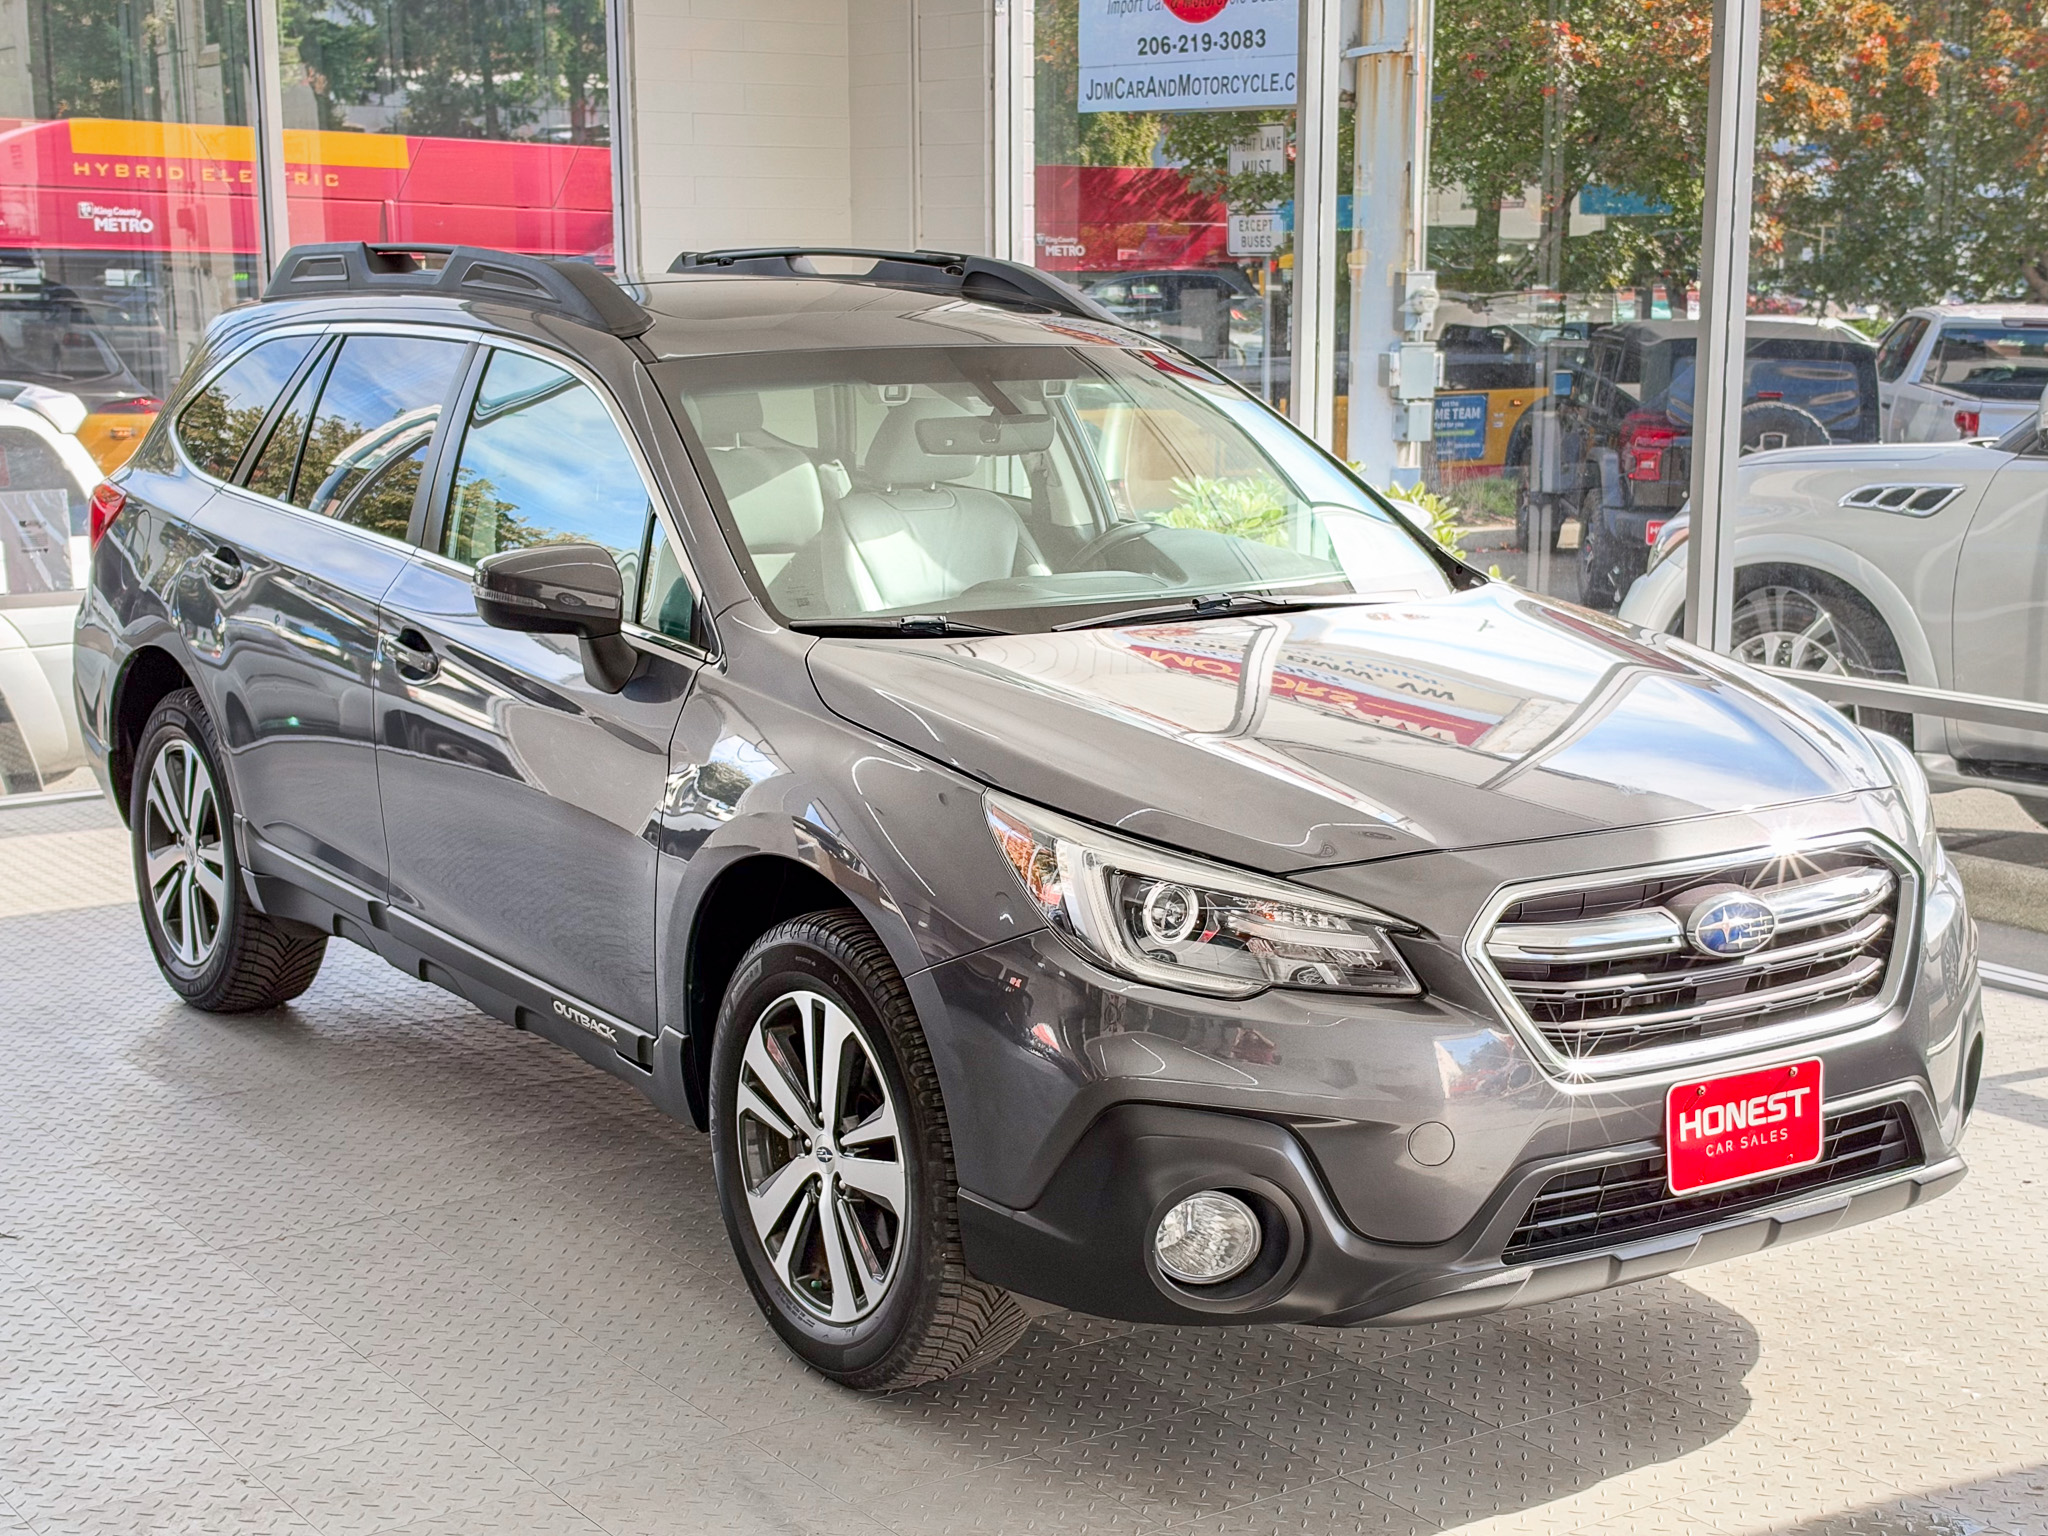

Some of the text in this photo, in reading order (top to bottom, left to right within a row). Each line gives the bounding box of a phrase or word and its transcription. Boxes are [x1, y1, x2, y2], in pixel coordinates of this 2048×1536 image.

[1260, 136, 1282, 151] LANE
[73, 161, 339, 188] HYBRID ELERIC
[1242, 159, 1271, 175] MUST
[94, 206, 142, 219] King County
[94, 217, 154, 233] METRO
[1239, 219, 1273, 232] EXCEPT
[1241, 236, 1272, 247] BUSES
[1045, 245, 1086, 257] METRO
[1452, 407, 1480, 420] TEAM
[553, 1000, 617, 1043] OUTBACK
[1679, 1086, 1811, 1142] HONEST
[1705, 1127, 1789, 1157] CAR SALES
